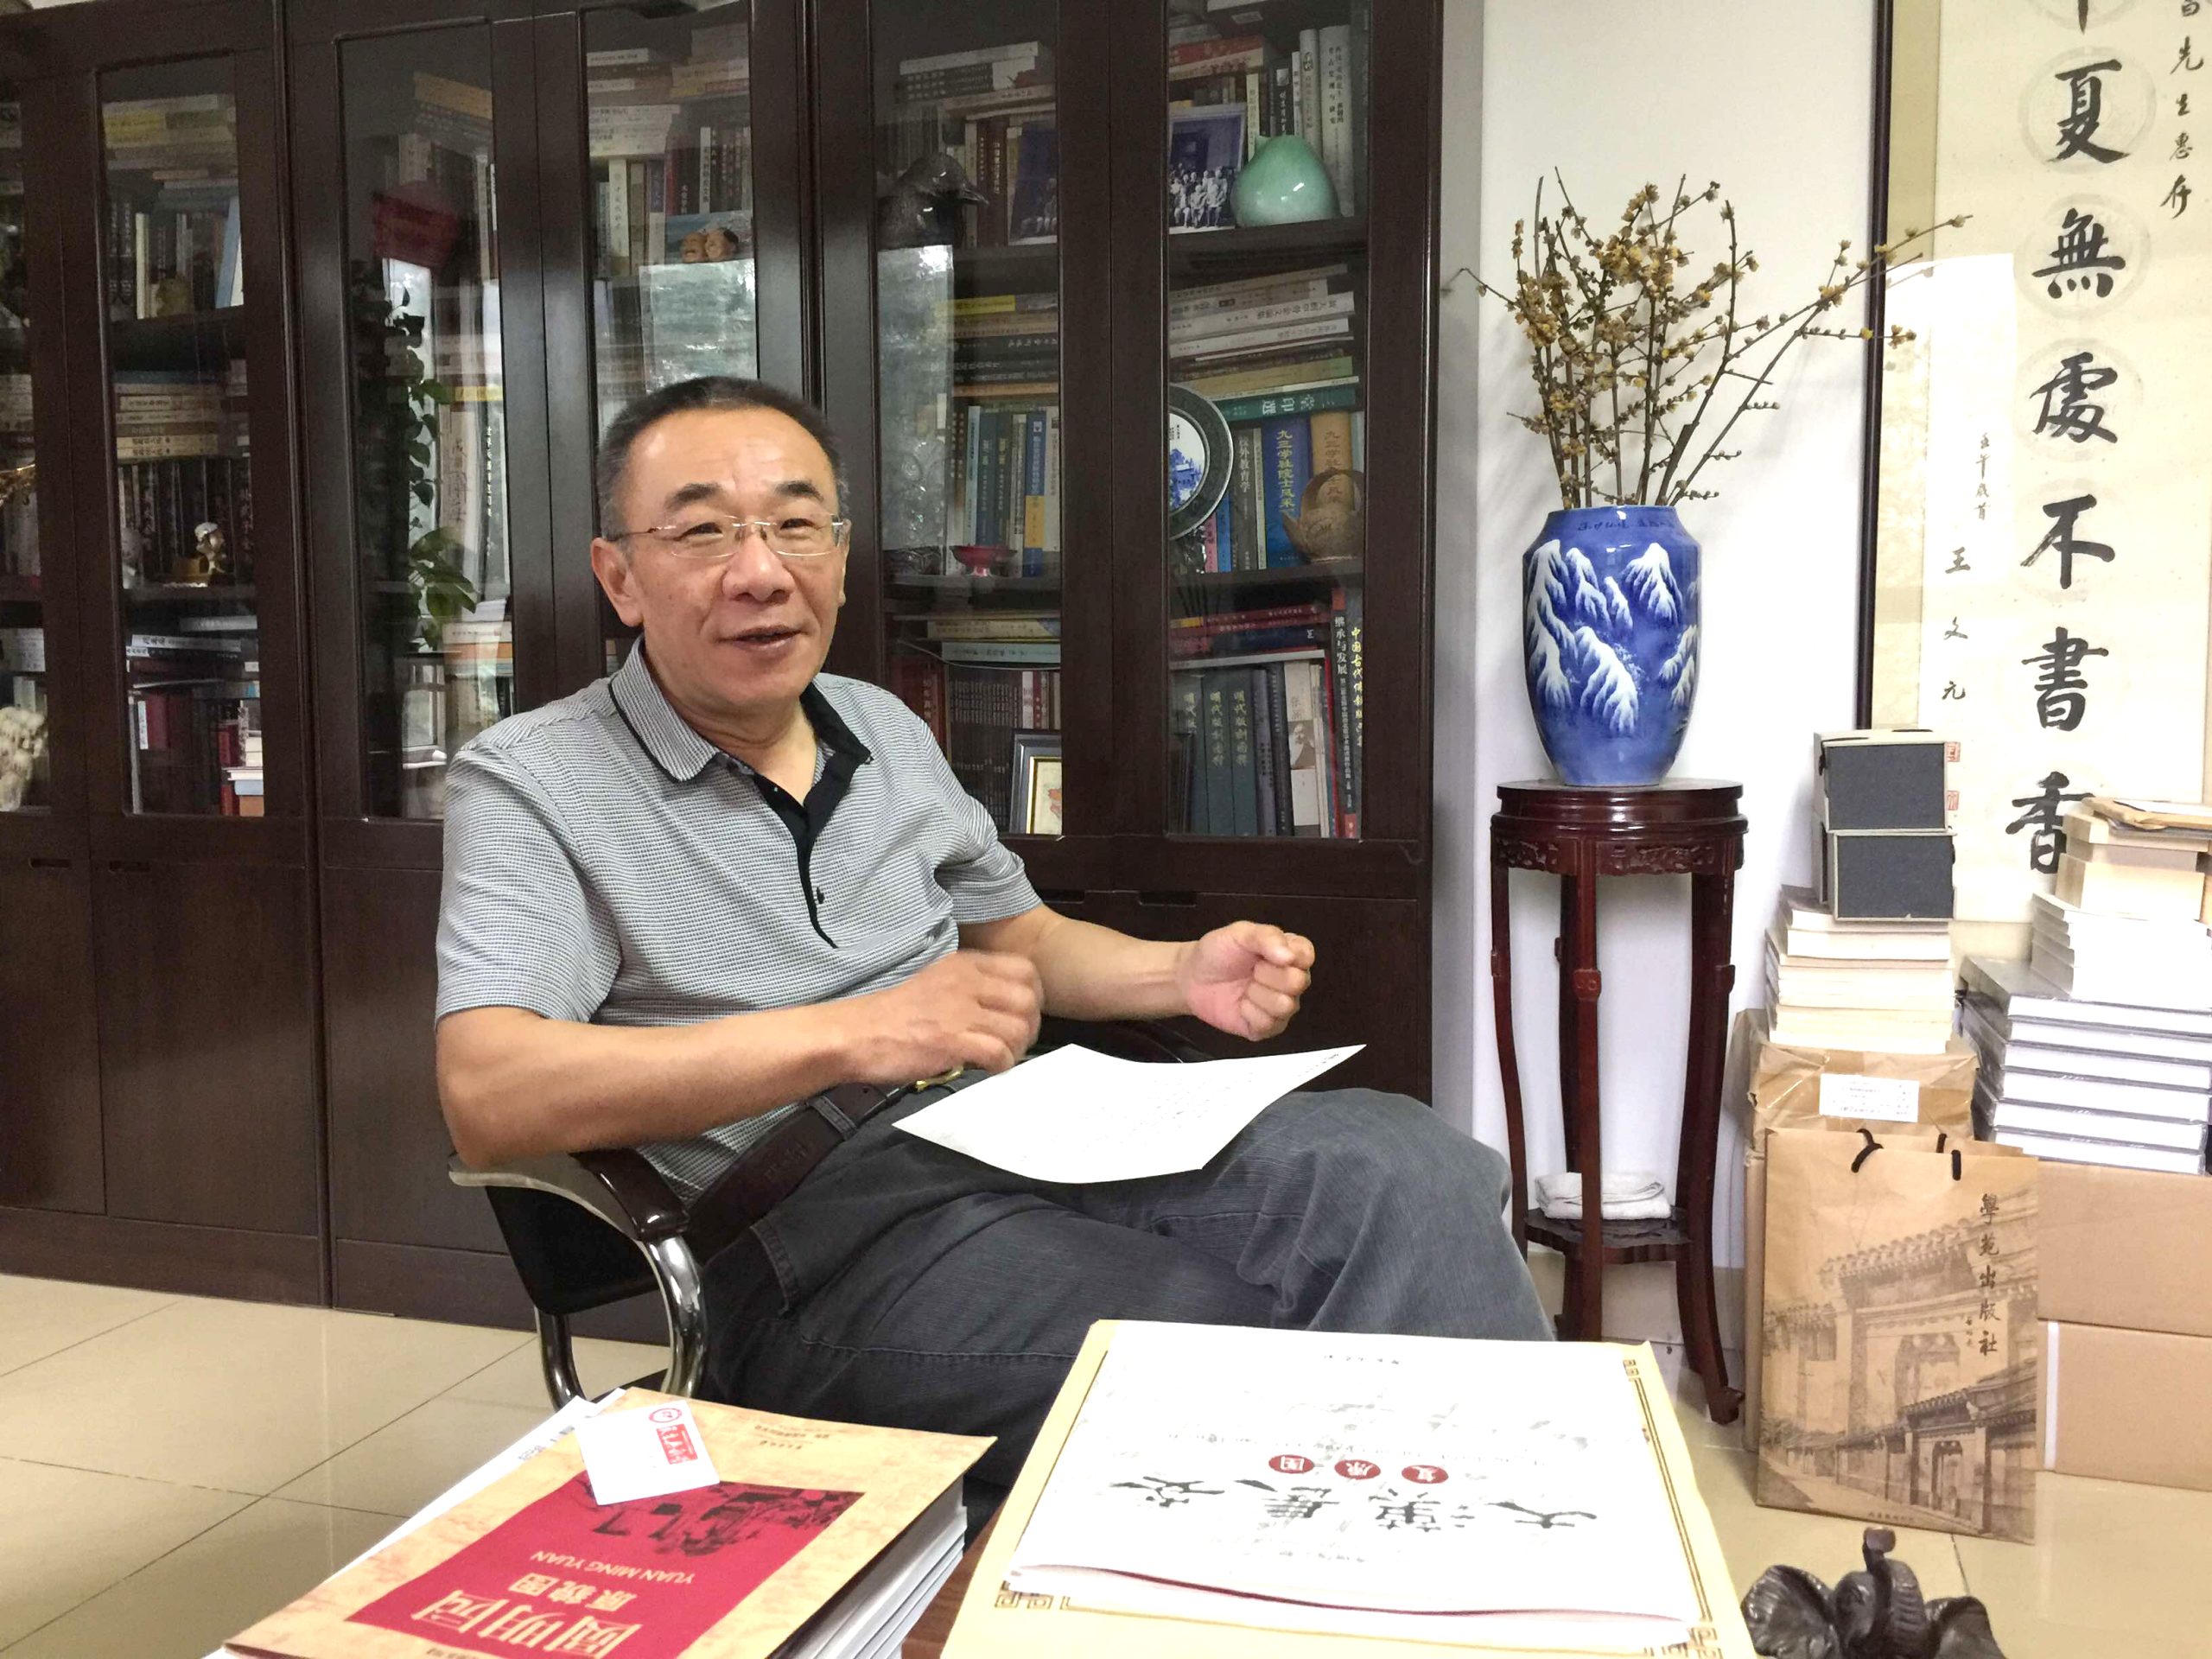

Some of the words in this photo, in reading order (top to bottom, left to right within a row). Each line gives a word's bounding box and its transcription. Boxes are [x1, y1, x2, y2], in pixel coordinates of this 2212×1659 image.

[2005, 0, 2131, 874] 夏無處不書香
[531, 1551, 585, 1570] YUAN
[584, 1560, 642, 1579] MING
[641, 1569, 695, 1585] YUAN
